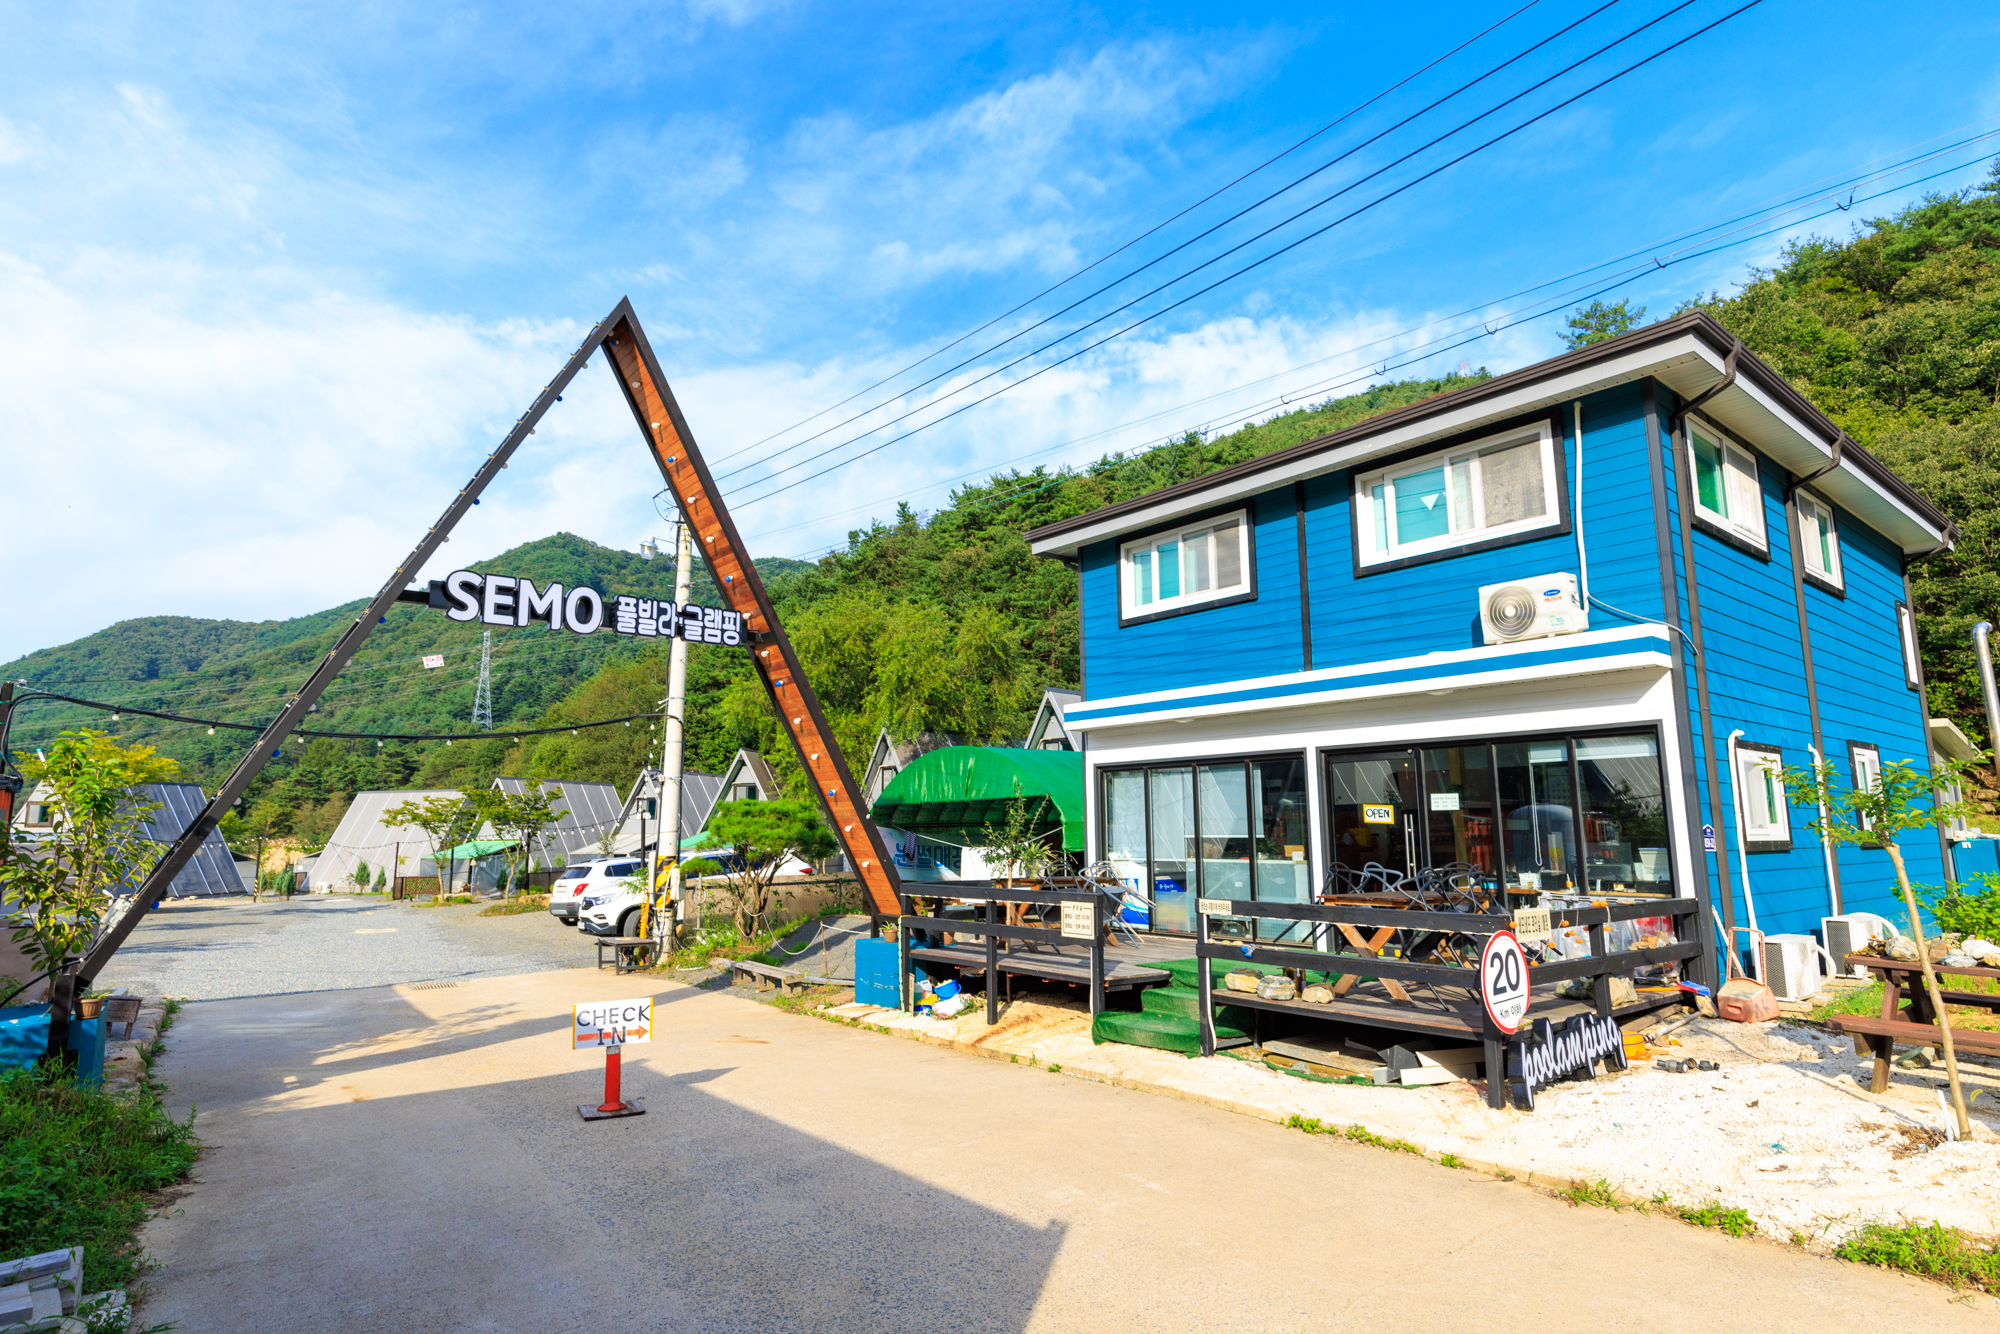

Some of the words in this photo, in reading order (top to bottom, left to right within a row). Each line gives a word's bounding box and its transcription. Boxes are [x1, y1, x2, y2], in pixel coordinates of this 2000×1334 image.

[446, 570, 603, 635] SEMO
[1365, 808, 1390, 819] OPEN
[1490, 948, 1520, 996] 20
[577, 1004, 651, 1027] CHECK
[1499, 1008, 1510, 1020] Km
[1511, 1003, 1522, 1016] 이하
[597, 1026, 626, 1046] IN
[1520, 1011, 1628, 1109] poolamping
